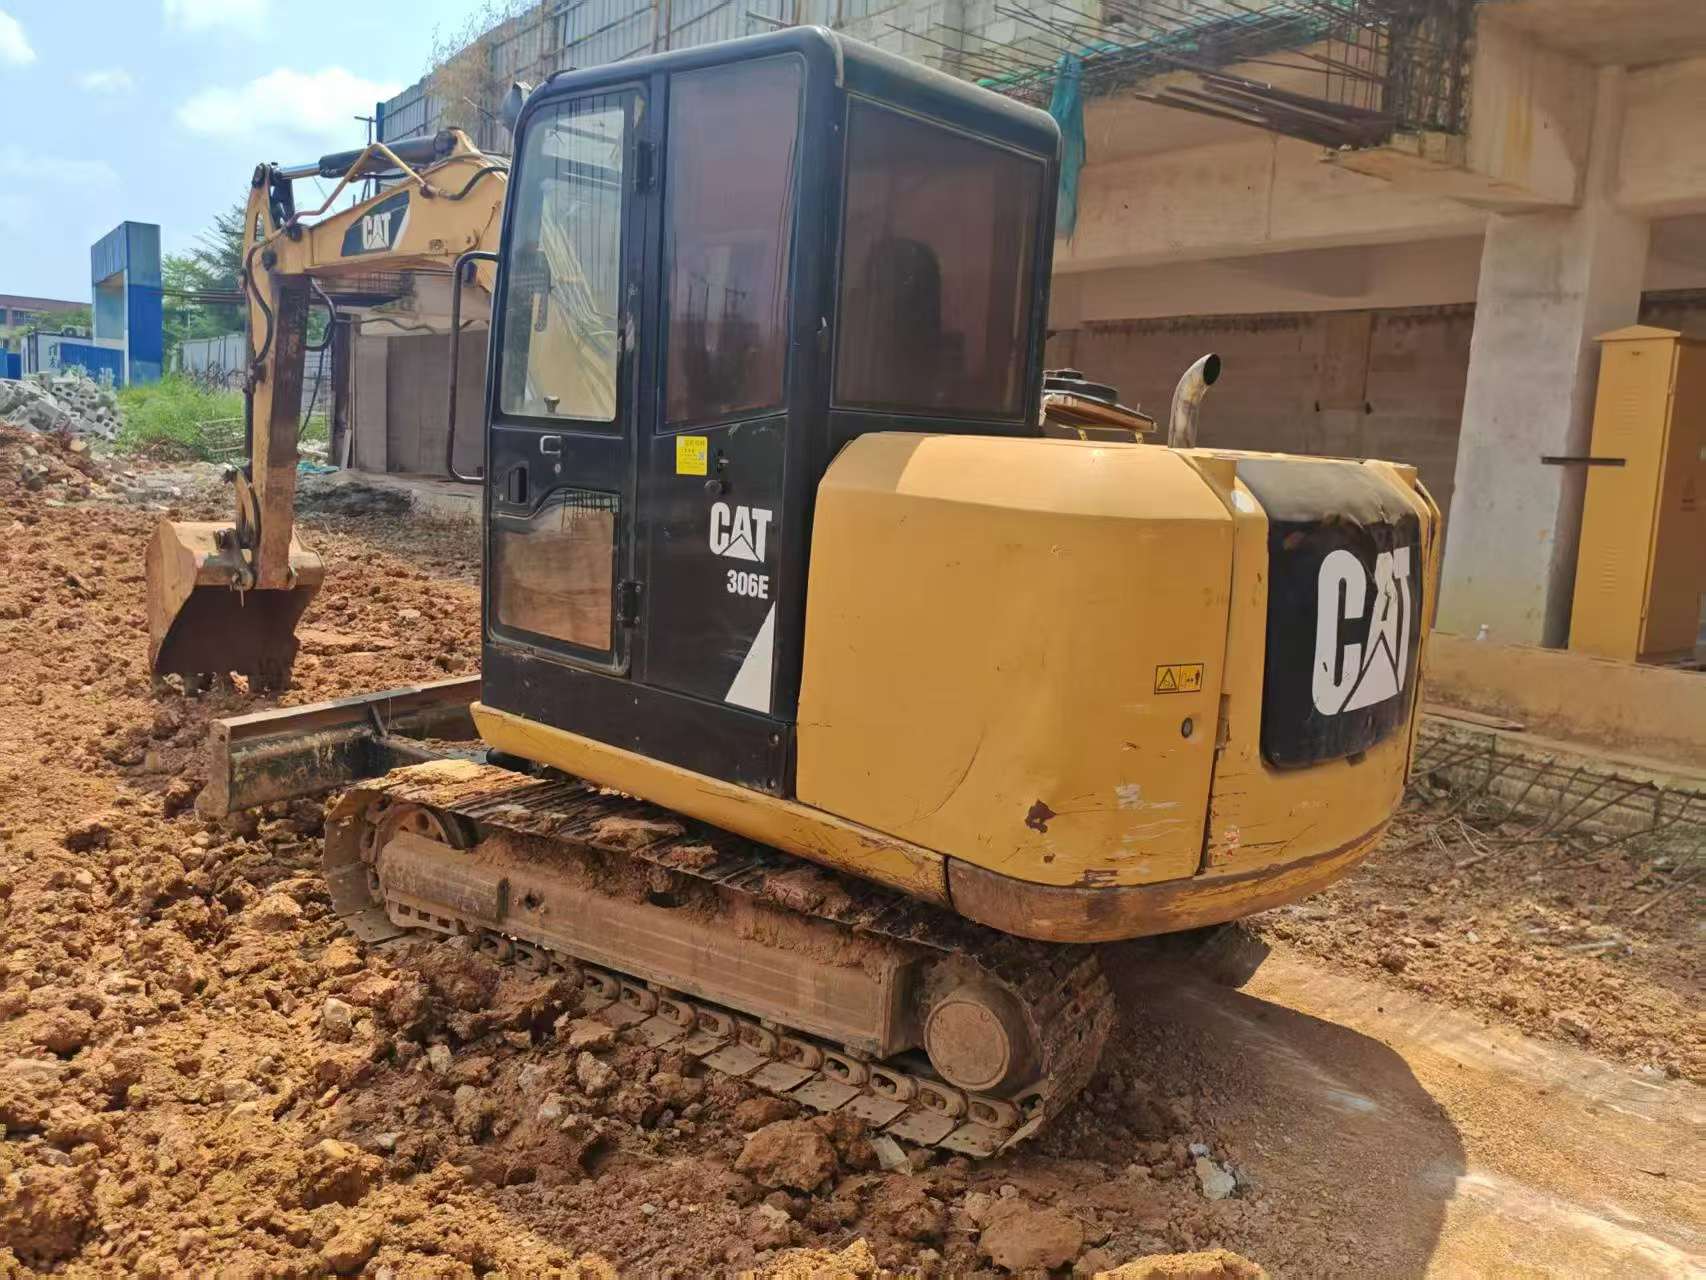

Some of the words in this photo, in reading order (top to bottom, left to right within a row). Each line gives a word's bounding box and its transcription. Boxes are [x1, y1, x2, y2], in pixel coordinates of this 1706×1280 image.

[362, 212, 391, 250] CAT
[709, 502, 773, 563] CAT
[726, 569, 769, 600] 306E
[1312, 546, 1411, 716] CAT
